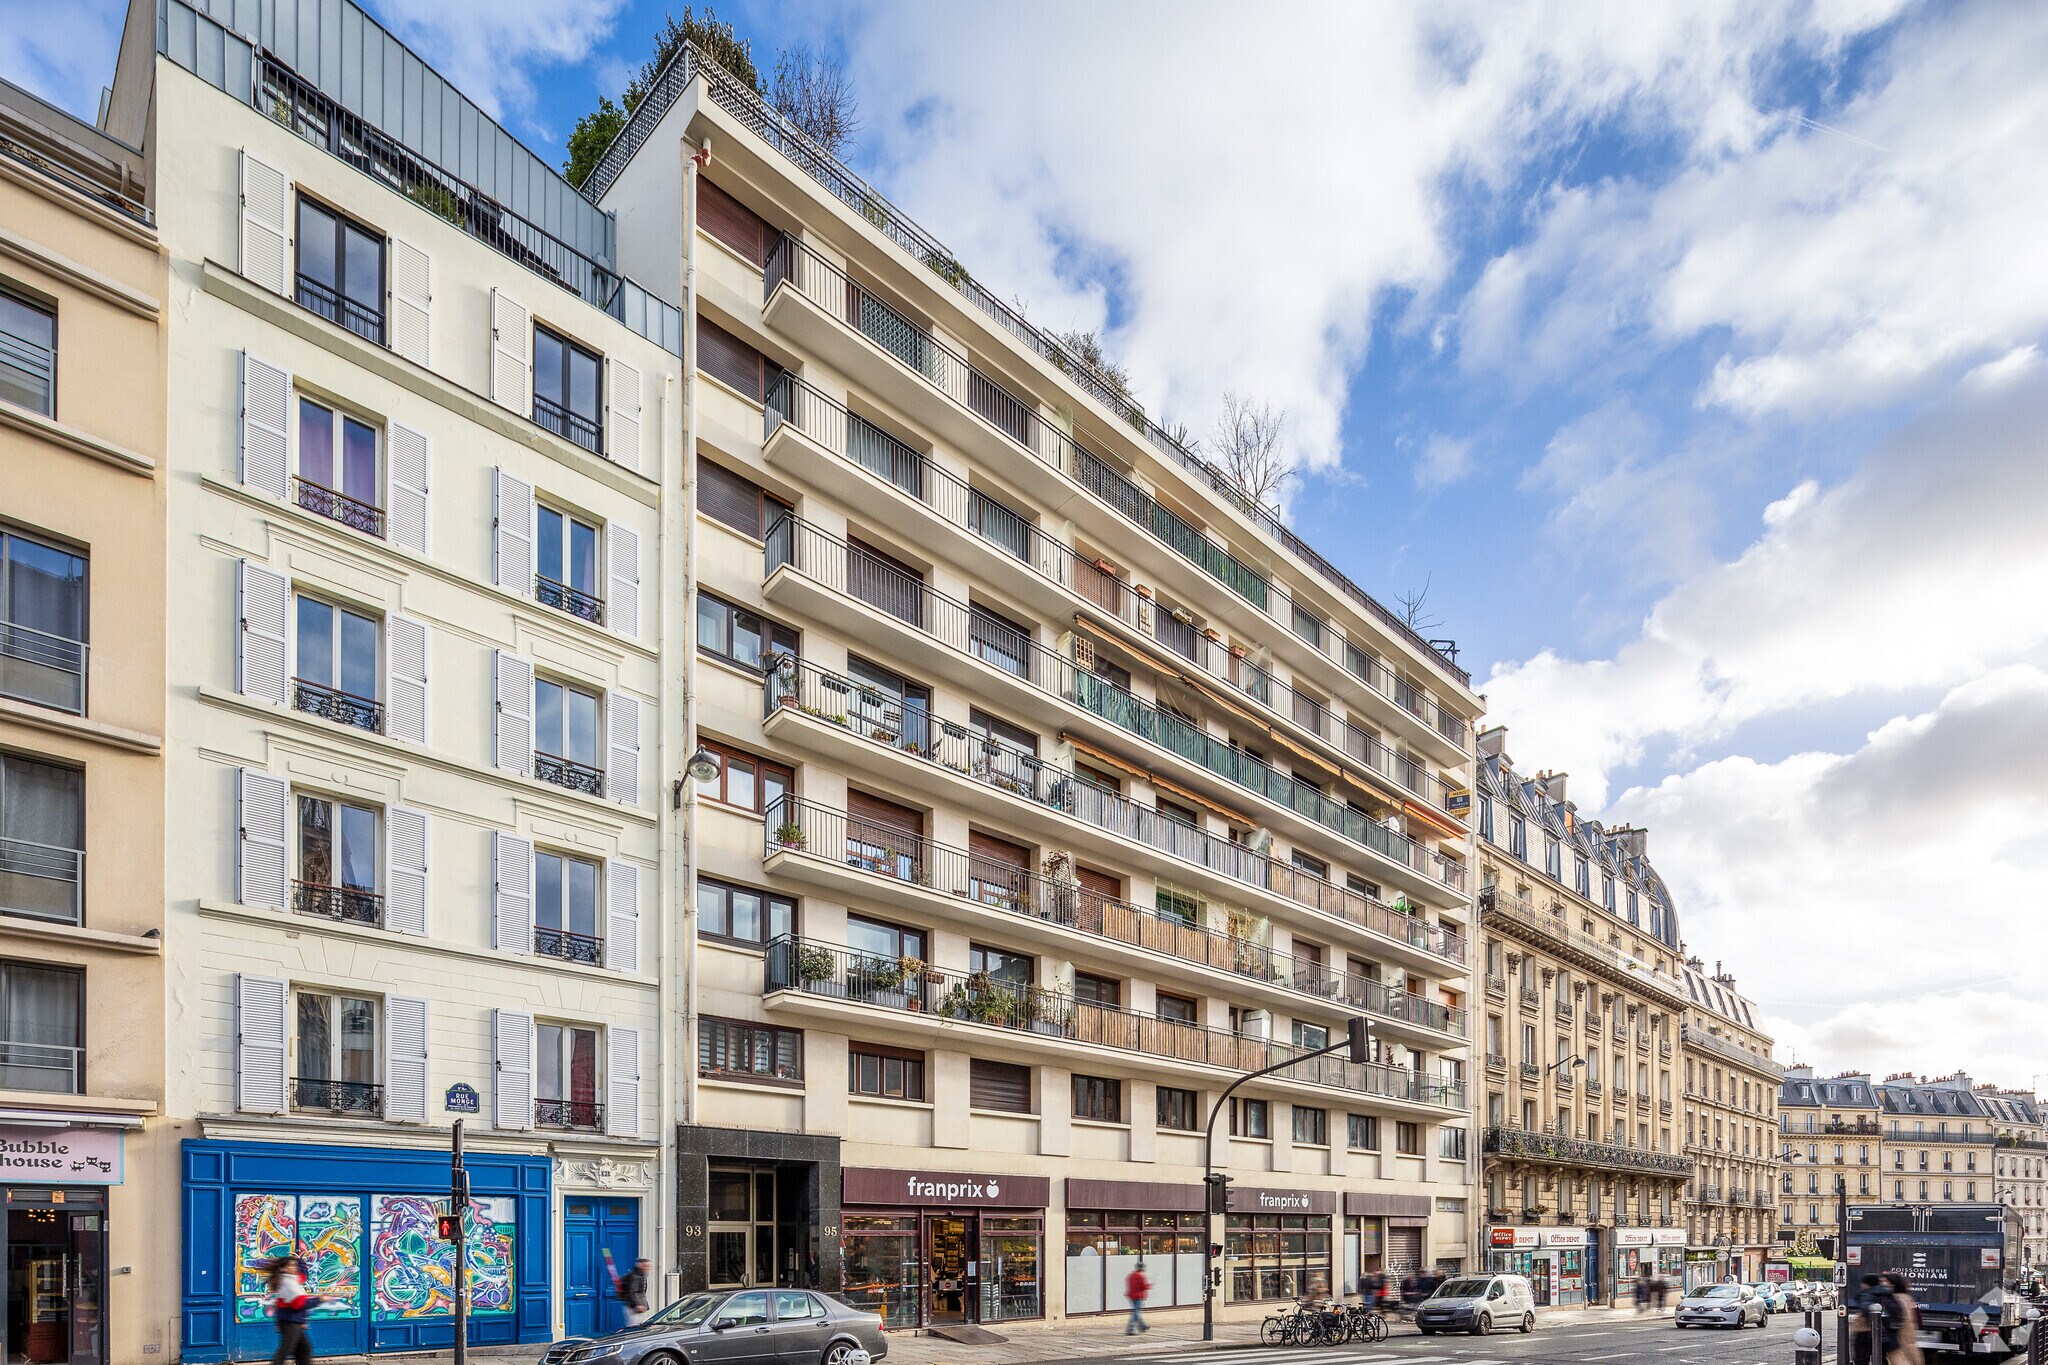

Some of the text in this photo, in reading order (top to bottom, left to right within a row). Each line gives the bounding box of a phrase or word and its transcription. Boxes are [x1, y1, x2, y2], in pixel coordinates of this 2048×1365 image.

[0, 1139, 70, 1155] Bubble
[0, 1153, 63, 1169] house
[907, 1176, 983, 1201] franprix
[1260, 1192, 1300, 1210] franprix
[685, 1225, 702, 1237] 93
[824, 1226, 838, 1237] 95
[1551, 1234, 1566, 1243] Office
